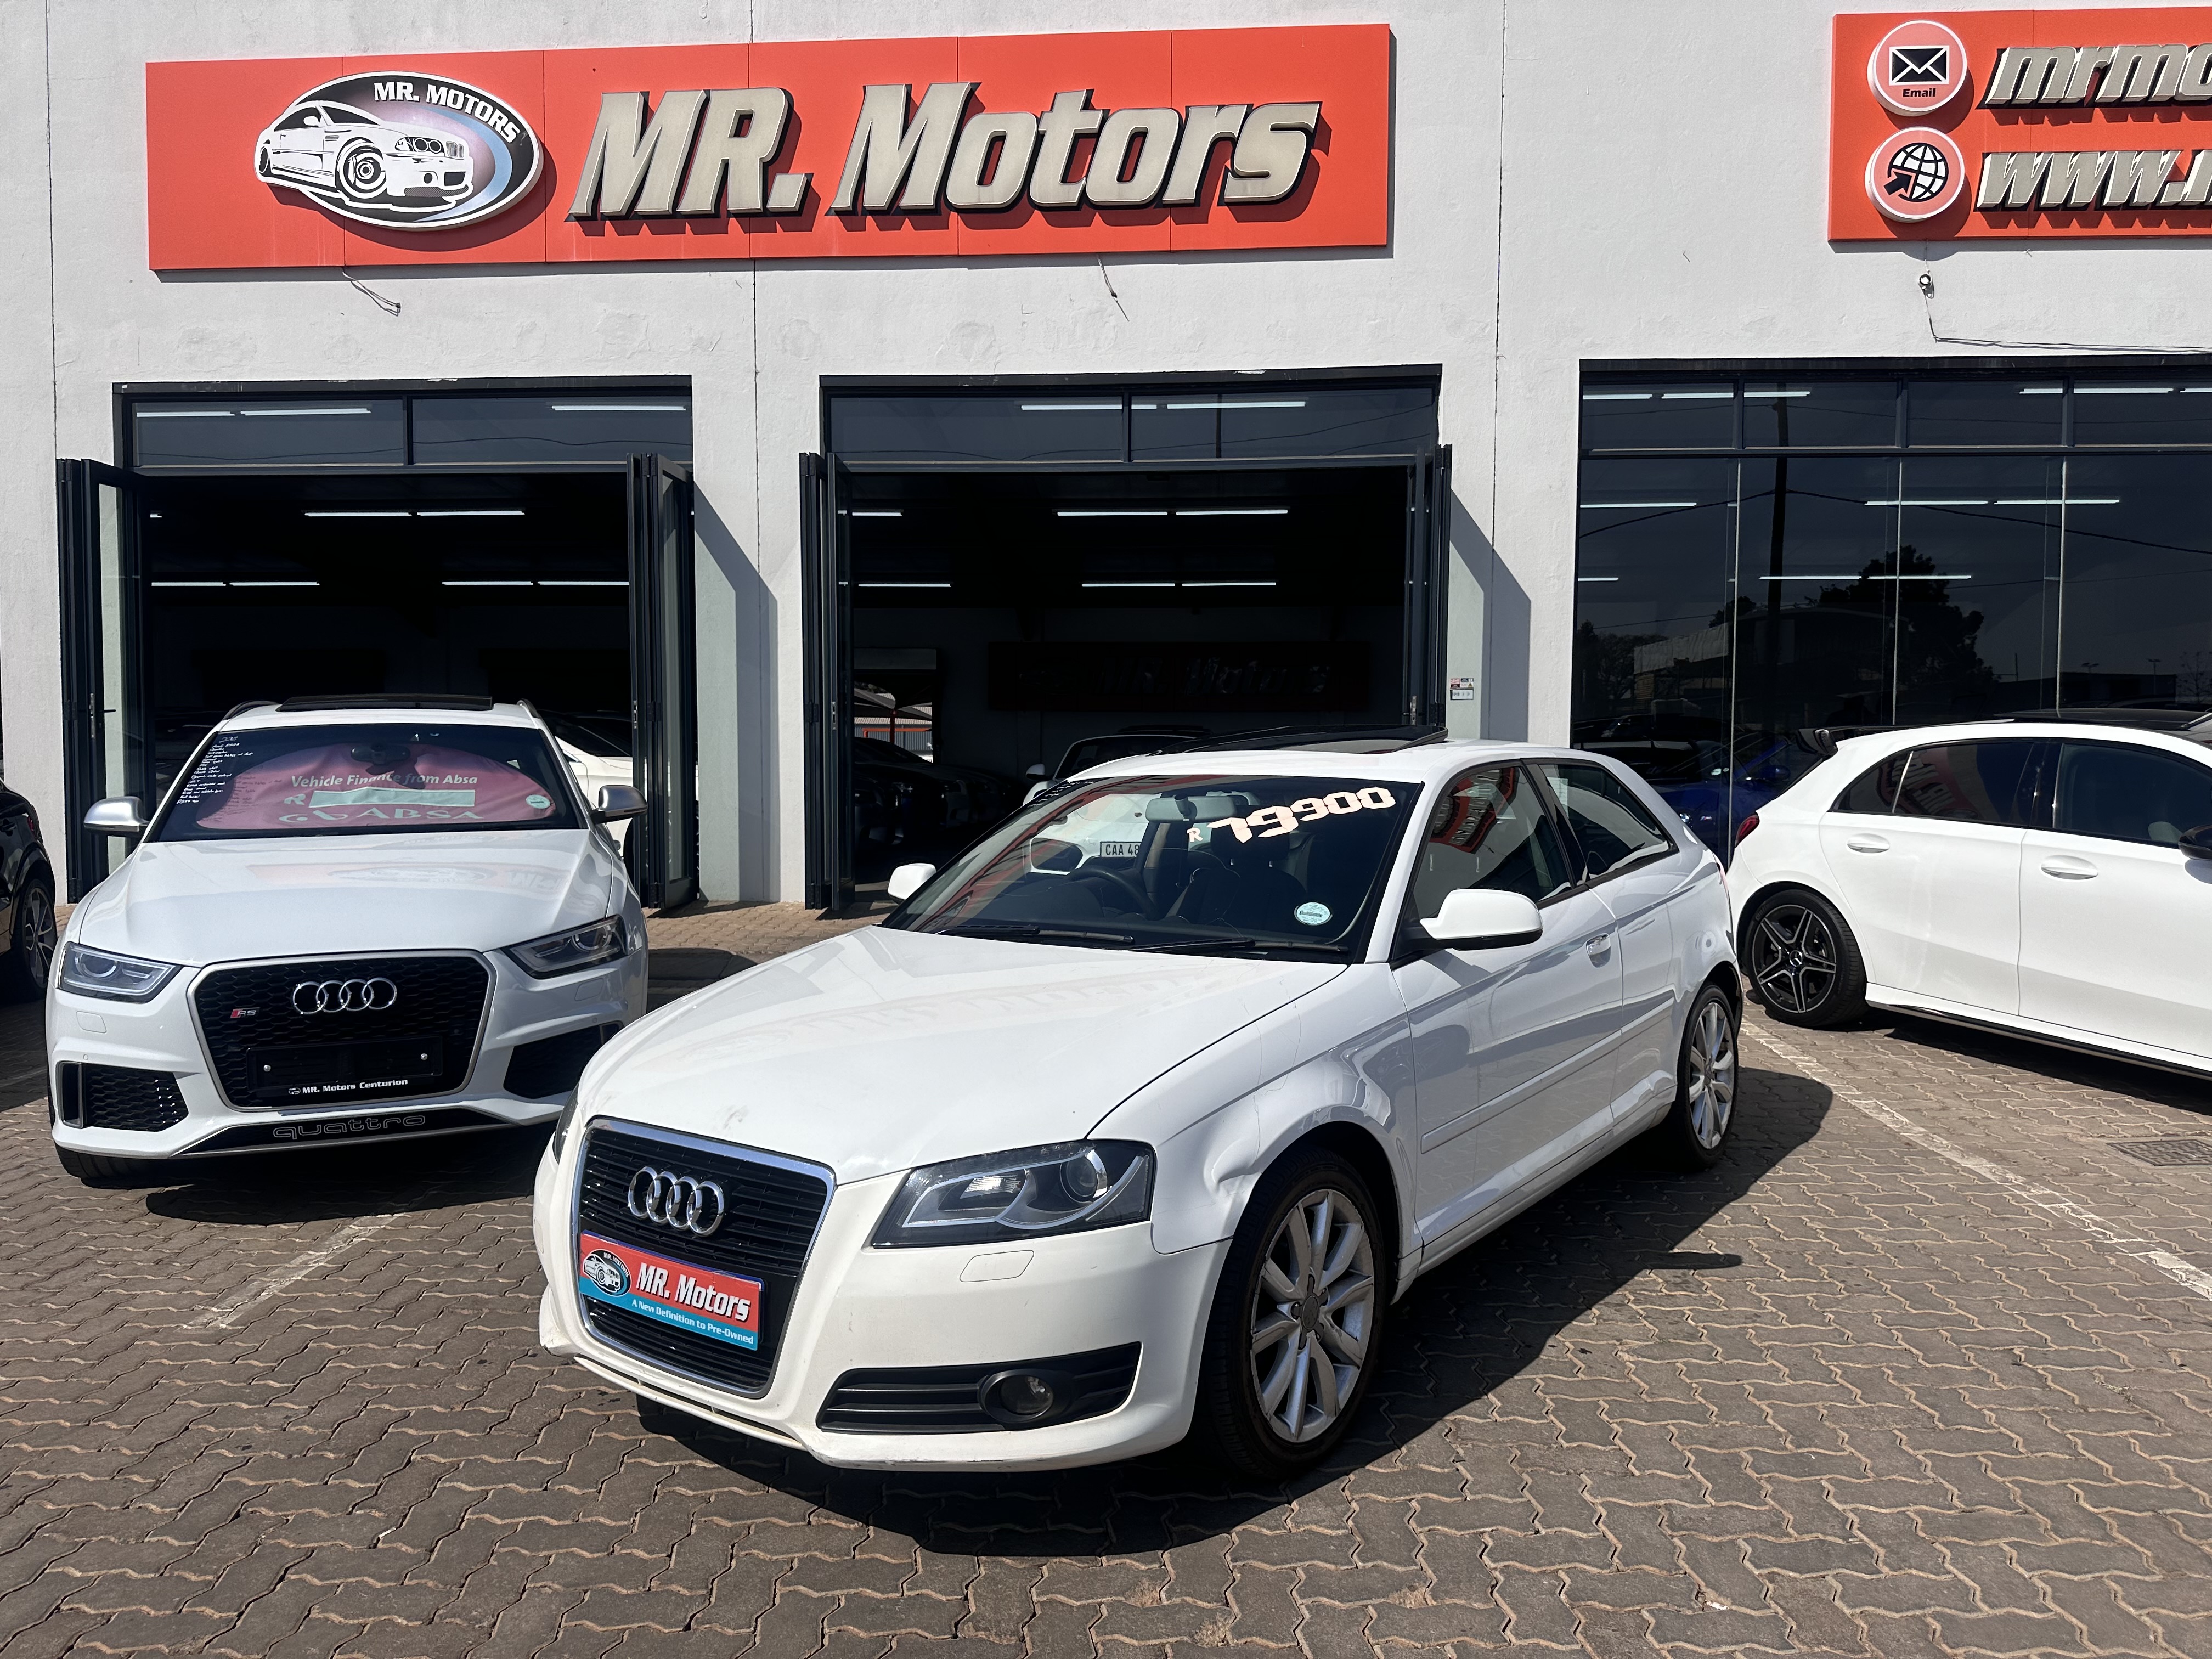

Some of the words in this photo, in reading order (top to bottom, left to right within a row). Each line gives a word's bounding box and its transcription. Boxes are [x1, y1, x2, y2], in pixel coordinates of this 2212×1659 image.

[1902, 88, 1937, 98] Email
[374, 82, 420, 102] MR.
[426, 84, 521, 143] MOTORS
[567, 86, 811, 218] MR.
[831, 81, 1321, 214] Motors
[291, 775, 343, 787] Vehicle
[347, 773, 400, 785] Finance
[405, 773, 439, 785] from
[442, 774, 478, 785] Absa
[283, 793, 306, 805] R
[357, 807, 484, 820] ABSA
[1186, 827, 1203, 843] R
[1206, 787, 1396, 844] 79900
[1105, 844, 1124, 855] CAA
[323, 1083, 356, 1092] Motors
[359, 1079, 408, 1089] Centurion
[273, 1115, 426, 1140] quattro
[612, 1256, 629, 1278] MOTORS
[636, 1262, 670, 1299] MR.
[675, 1274, 751, 1321] Motors
[632, 1299, 637, 1307] A
[639, 1301, 655, 1313] New
[656, 1305, 695, 1326] Definition
[696, 1320, 706, 1329] to
[707, 1323, 754, 1344] Pre-Owned
